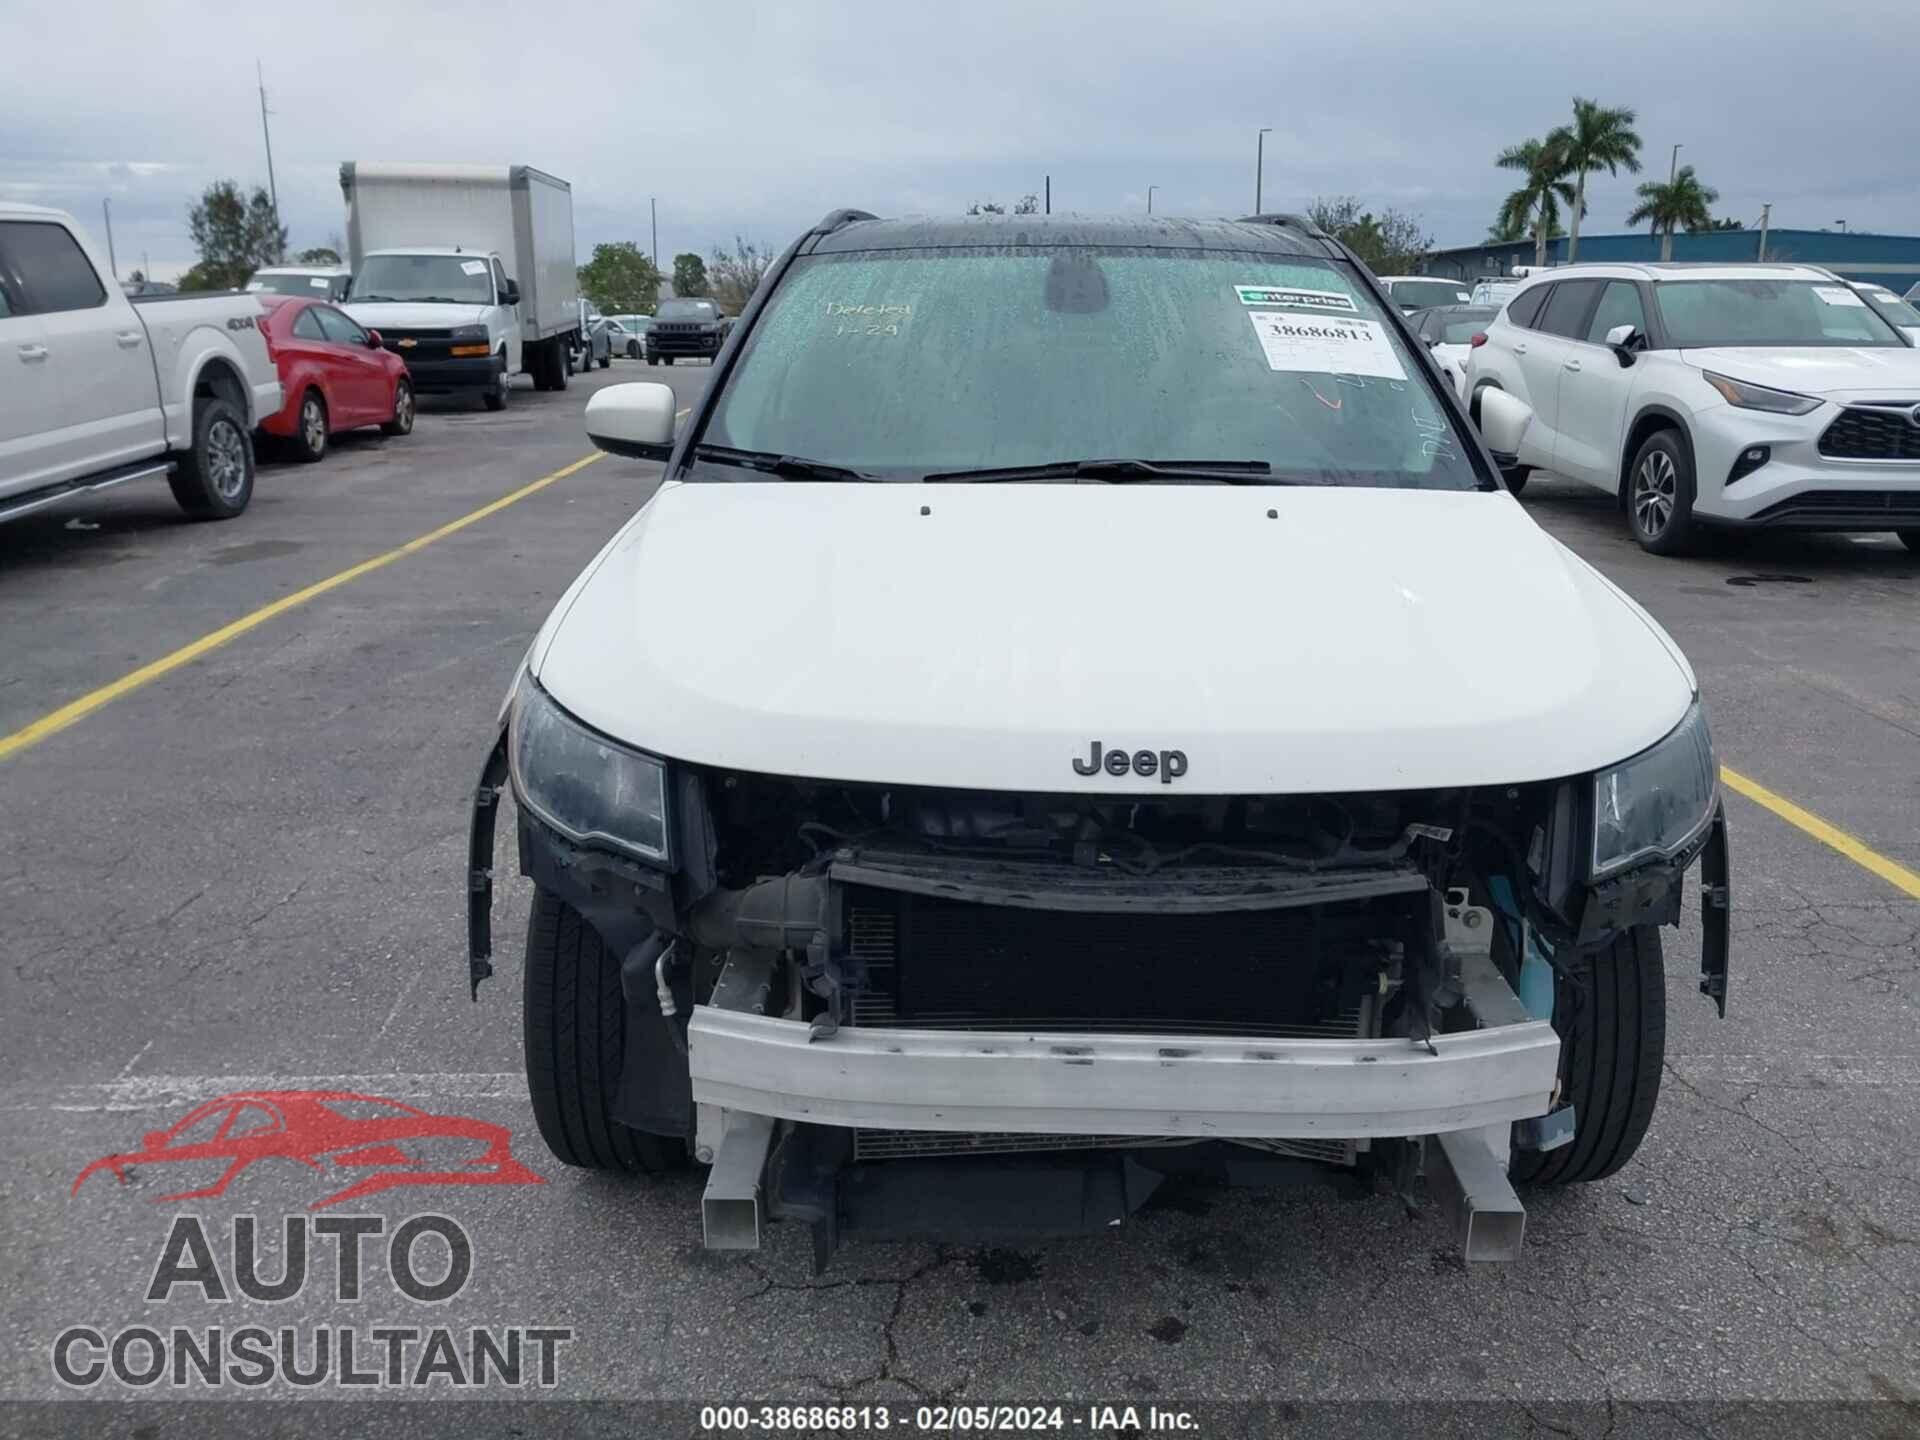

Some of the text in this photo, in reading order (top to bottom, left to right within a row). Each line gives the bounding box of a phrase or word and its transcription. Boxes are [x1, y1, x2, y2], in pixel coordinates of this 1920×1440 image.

[1248, 291, 1351, 307] enterprise
[1268, 323, 1373, 342] 38686813
[1072, 740, 1188, 784] Jeep
